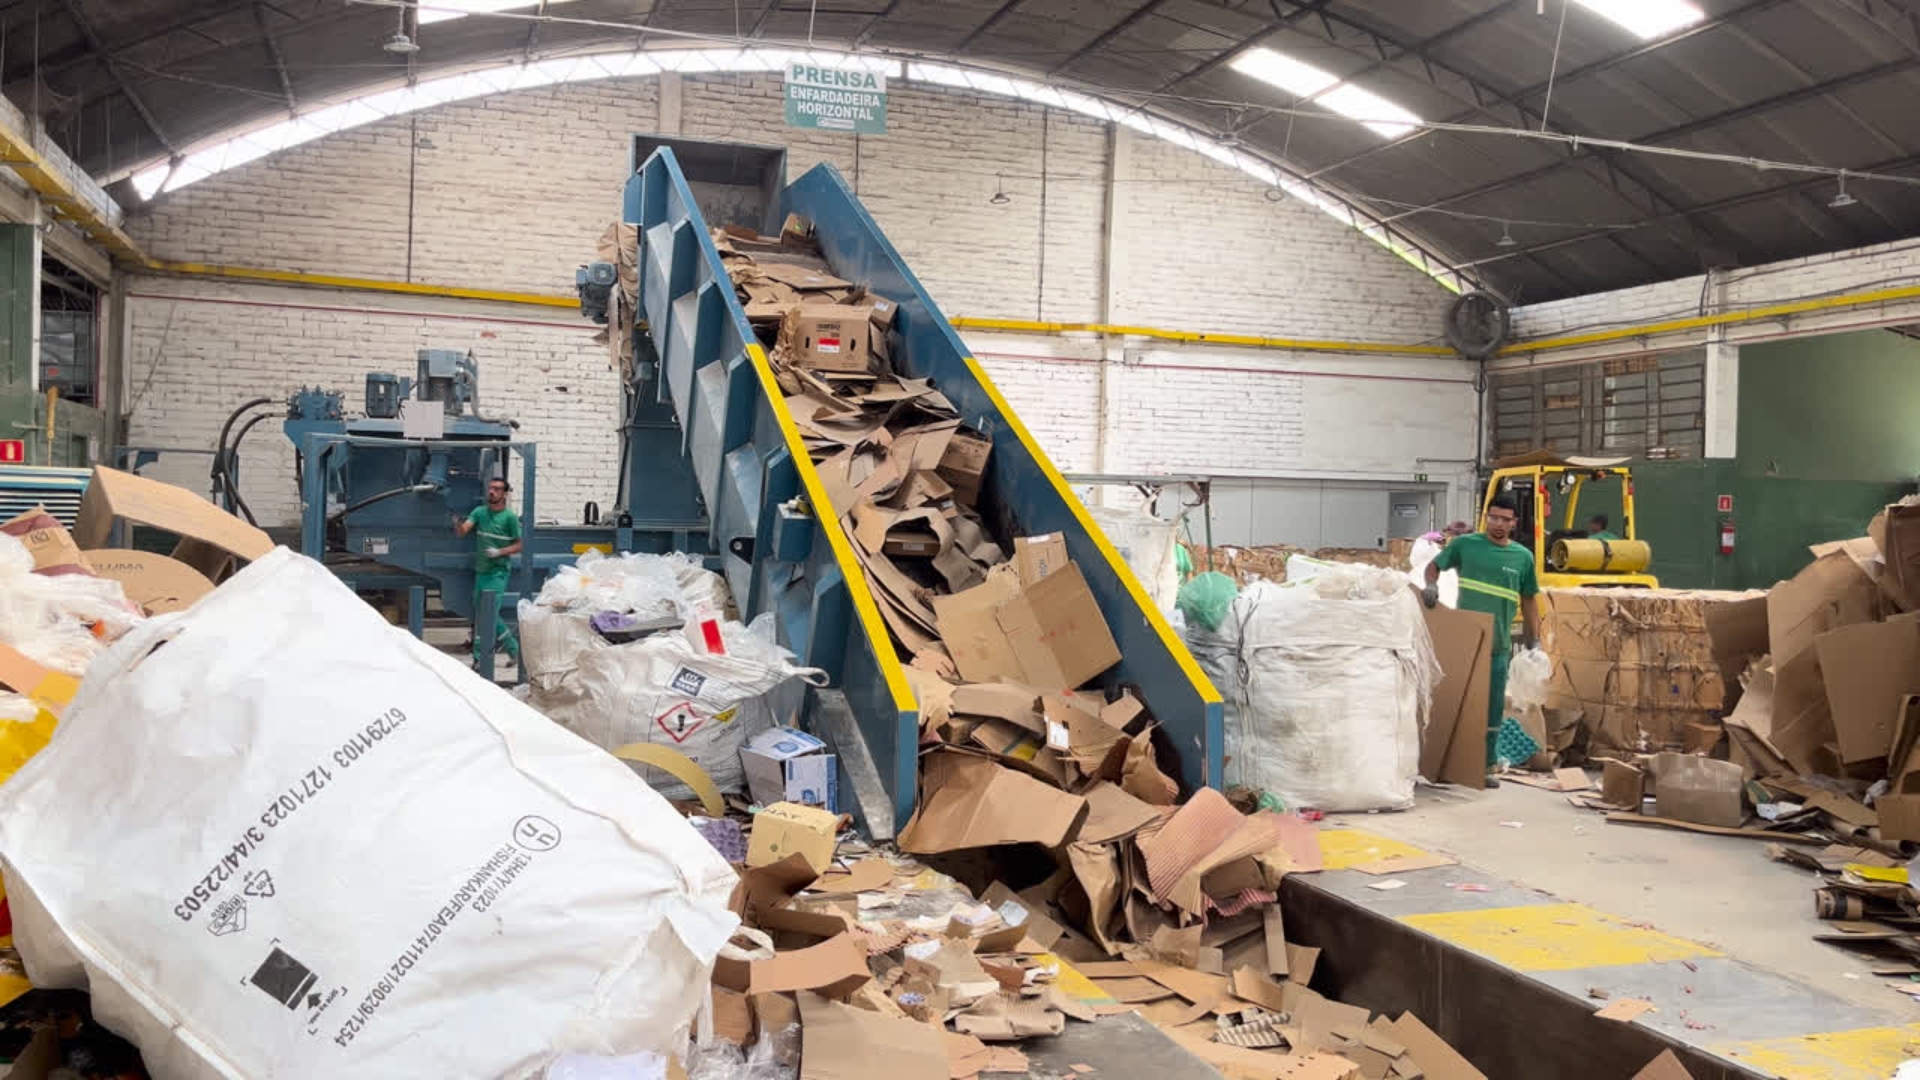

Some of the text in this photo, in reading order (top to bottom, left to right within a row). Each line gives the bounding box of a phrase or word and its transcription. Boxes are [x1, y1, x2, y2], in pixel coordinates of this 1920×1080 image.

[793, 65, 877, 89] PRENSA
[790, 86, 880, 107] ENFARDADEIRA
[797, 102, 874, 121] HORIZONTAL
[174, 707, 407, 921] 67291103 1271023 3/44/22503
